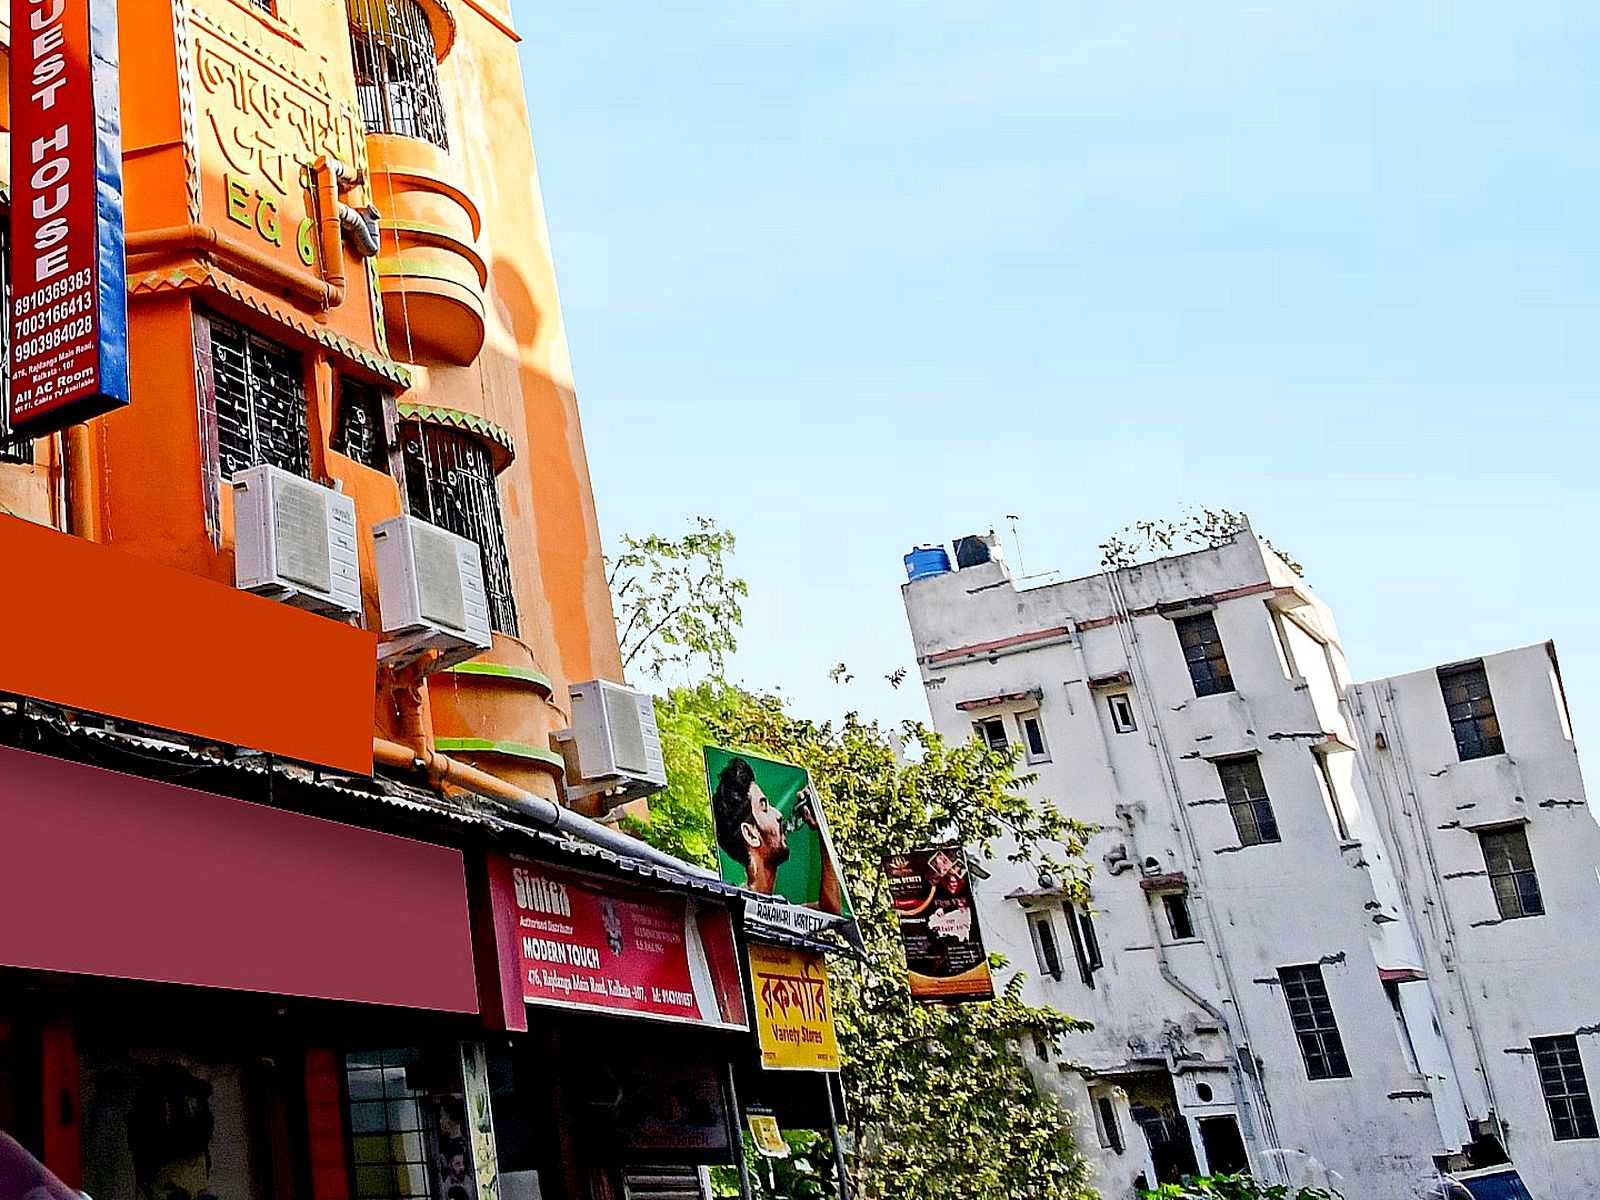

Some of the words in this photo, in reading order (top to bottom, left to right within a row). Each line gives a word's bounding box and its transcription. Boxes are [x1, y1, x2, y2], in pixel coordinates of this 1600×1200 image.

[31, 123, 70, 283] HOUSE
[15, 267, 91, 317] 8910369383
[15, 291, 92, 340] 7003166413
[15, 315, 92, 363] 9903984028
[15, 389, 32, 406] All
[35, 381, 54, 397] AC
[57, 366, 94, 388] Room
[513, 867, 571, 918] Sintex
[523, 936, 568, 965] MODERN
[565, 943, 601, 970] TOUCH
[571, 973, 590, 992] Main
[757, 958, 828, 1023] রকমারি
[771, 1023, 801, 1046] Variety
[800, 1025, 823, 1044] Stores
